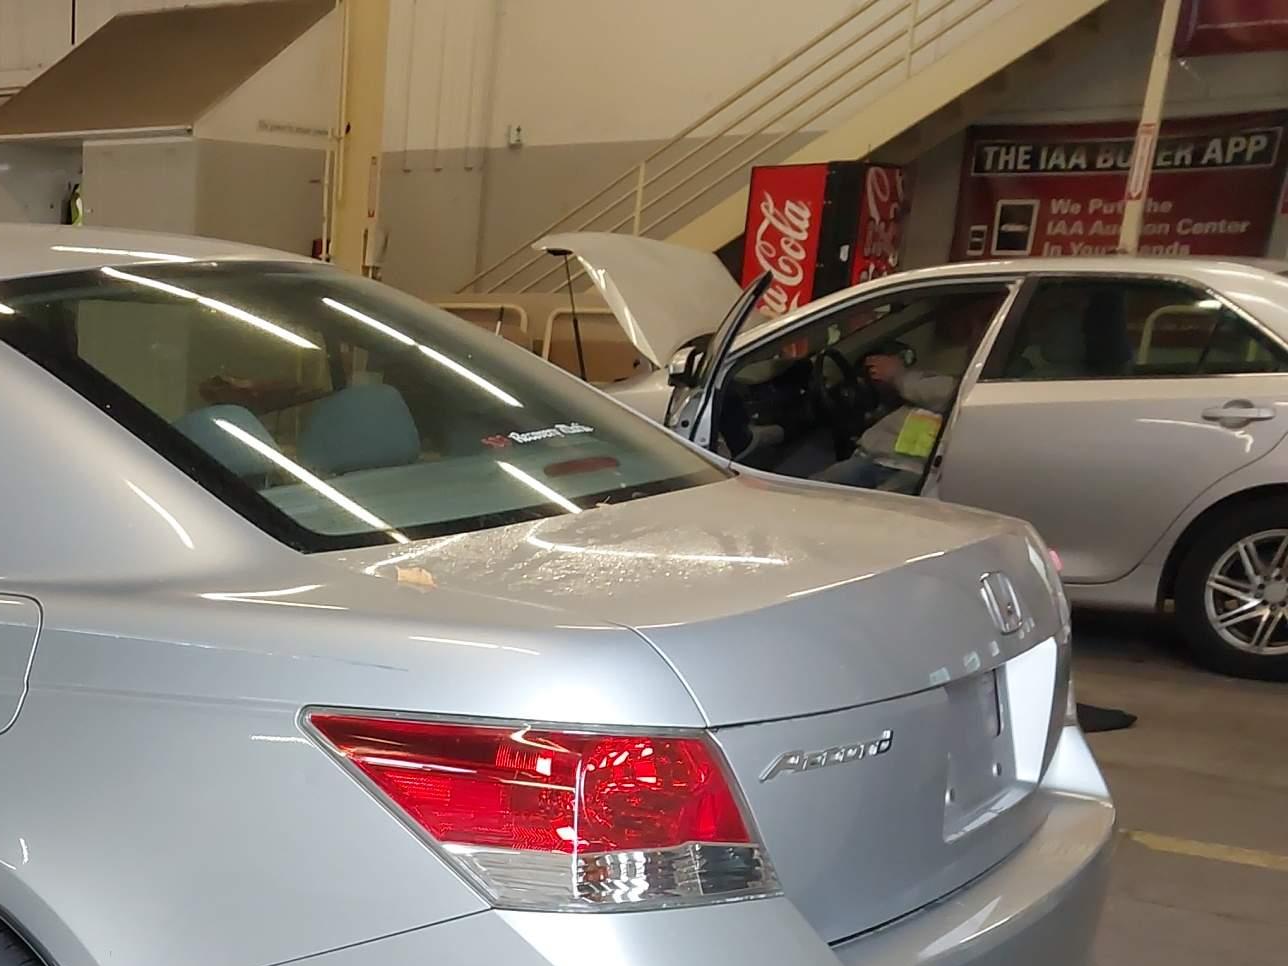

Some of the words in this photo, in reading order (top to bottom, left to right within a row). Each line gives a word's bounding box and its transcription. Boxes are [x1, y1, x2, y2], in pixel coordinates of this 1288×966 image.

[983, 145, 1033, 170] THE
[1039, 144, 1088, 169] IAA
[1095, 141, 1196, 168] BUER
[1201, 134, 1268, 164] APP
[1049, 198, 1082, 215] We
[1145, 197, 1173, 213] he
[1046, 219, 1083, 235] IAA
[1176, 217, 1250, 235] Center
[1140, 241, 1191, 256] ands
[758, 729, 894, 783] Accord
